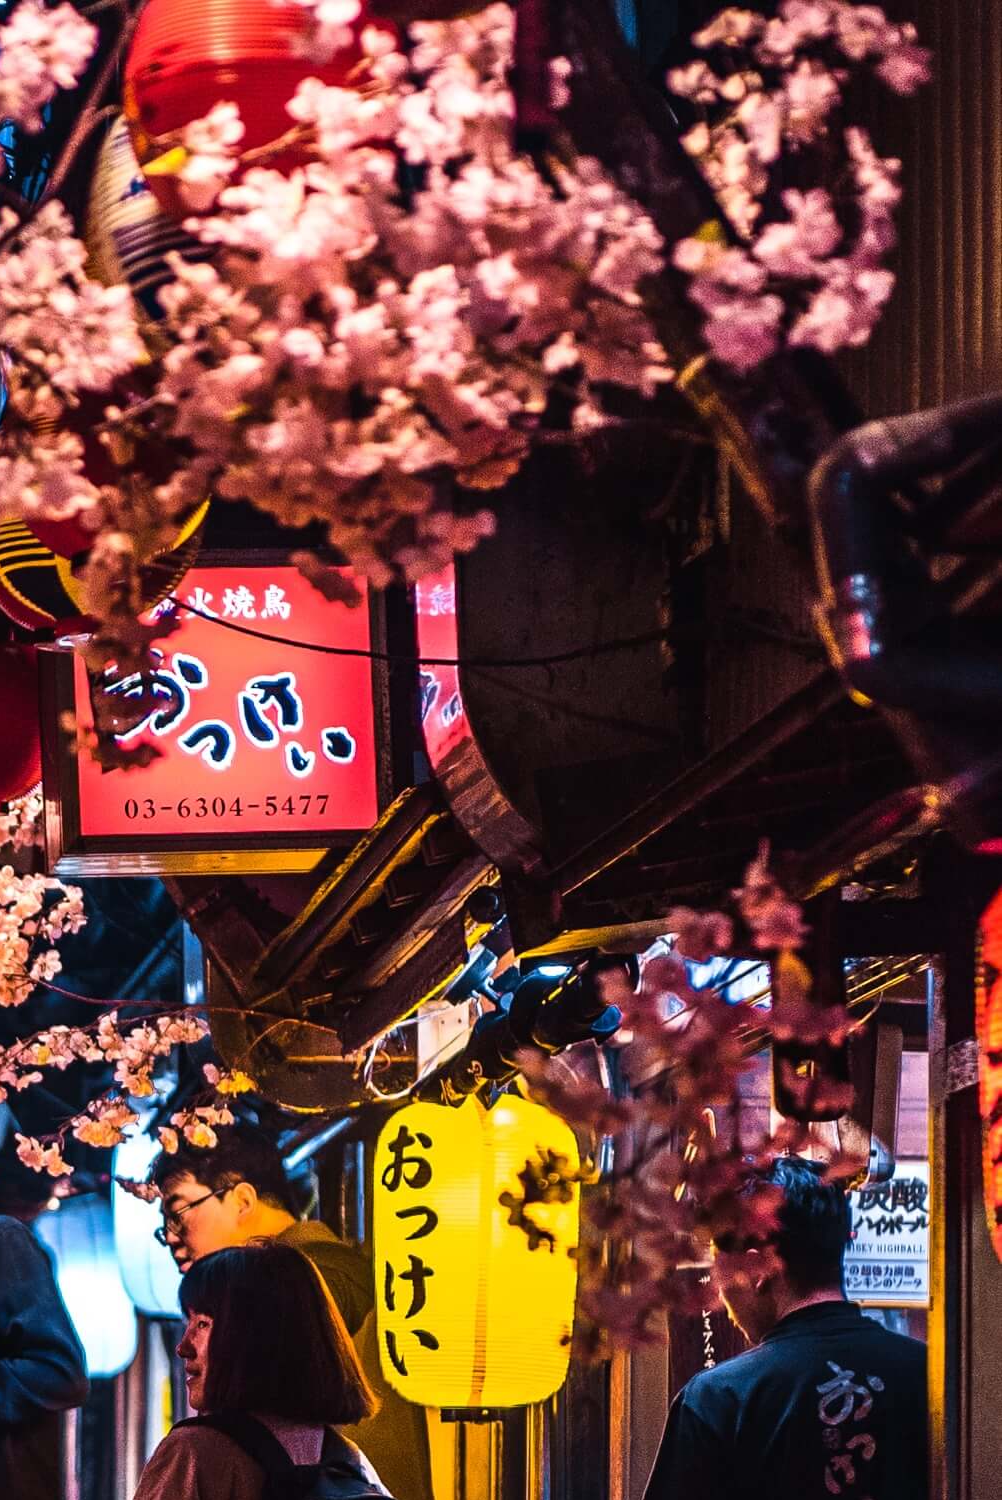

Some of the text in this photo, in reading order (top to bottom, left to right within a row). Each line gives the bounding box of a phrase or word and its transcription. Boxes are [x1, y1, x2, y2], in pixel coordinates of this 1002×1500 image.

[124, 794, 330, 820] 03-6304-5477
[853, 1215, 930, 1237] ハイボール
[381, 1125, 440, 1376] おっけい
[877, 1243, 925, 1255] HIGHBALL
